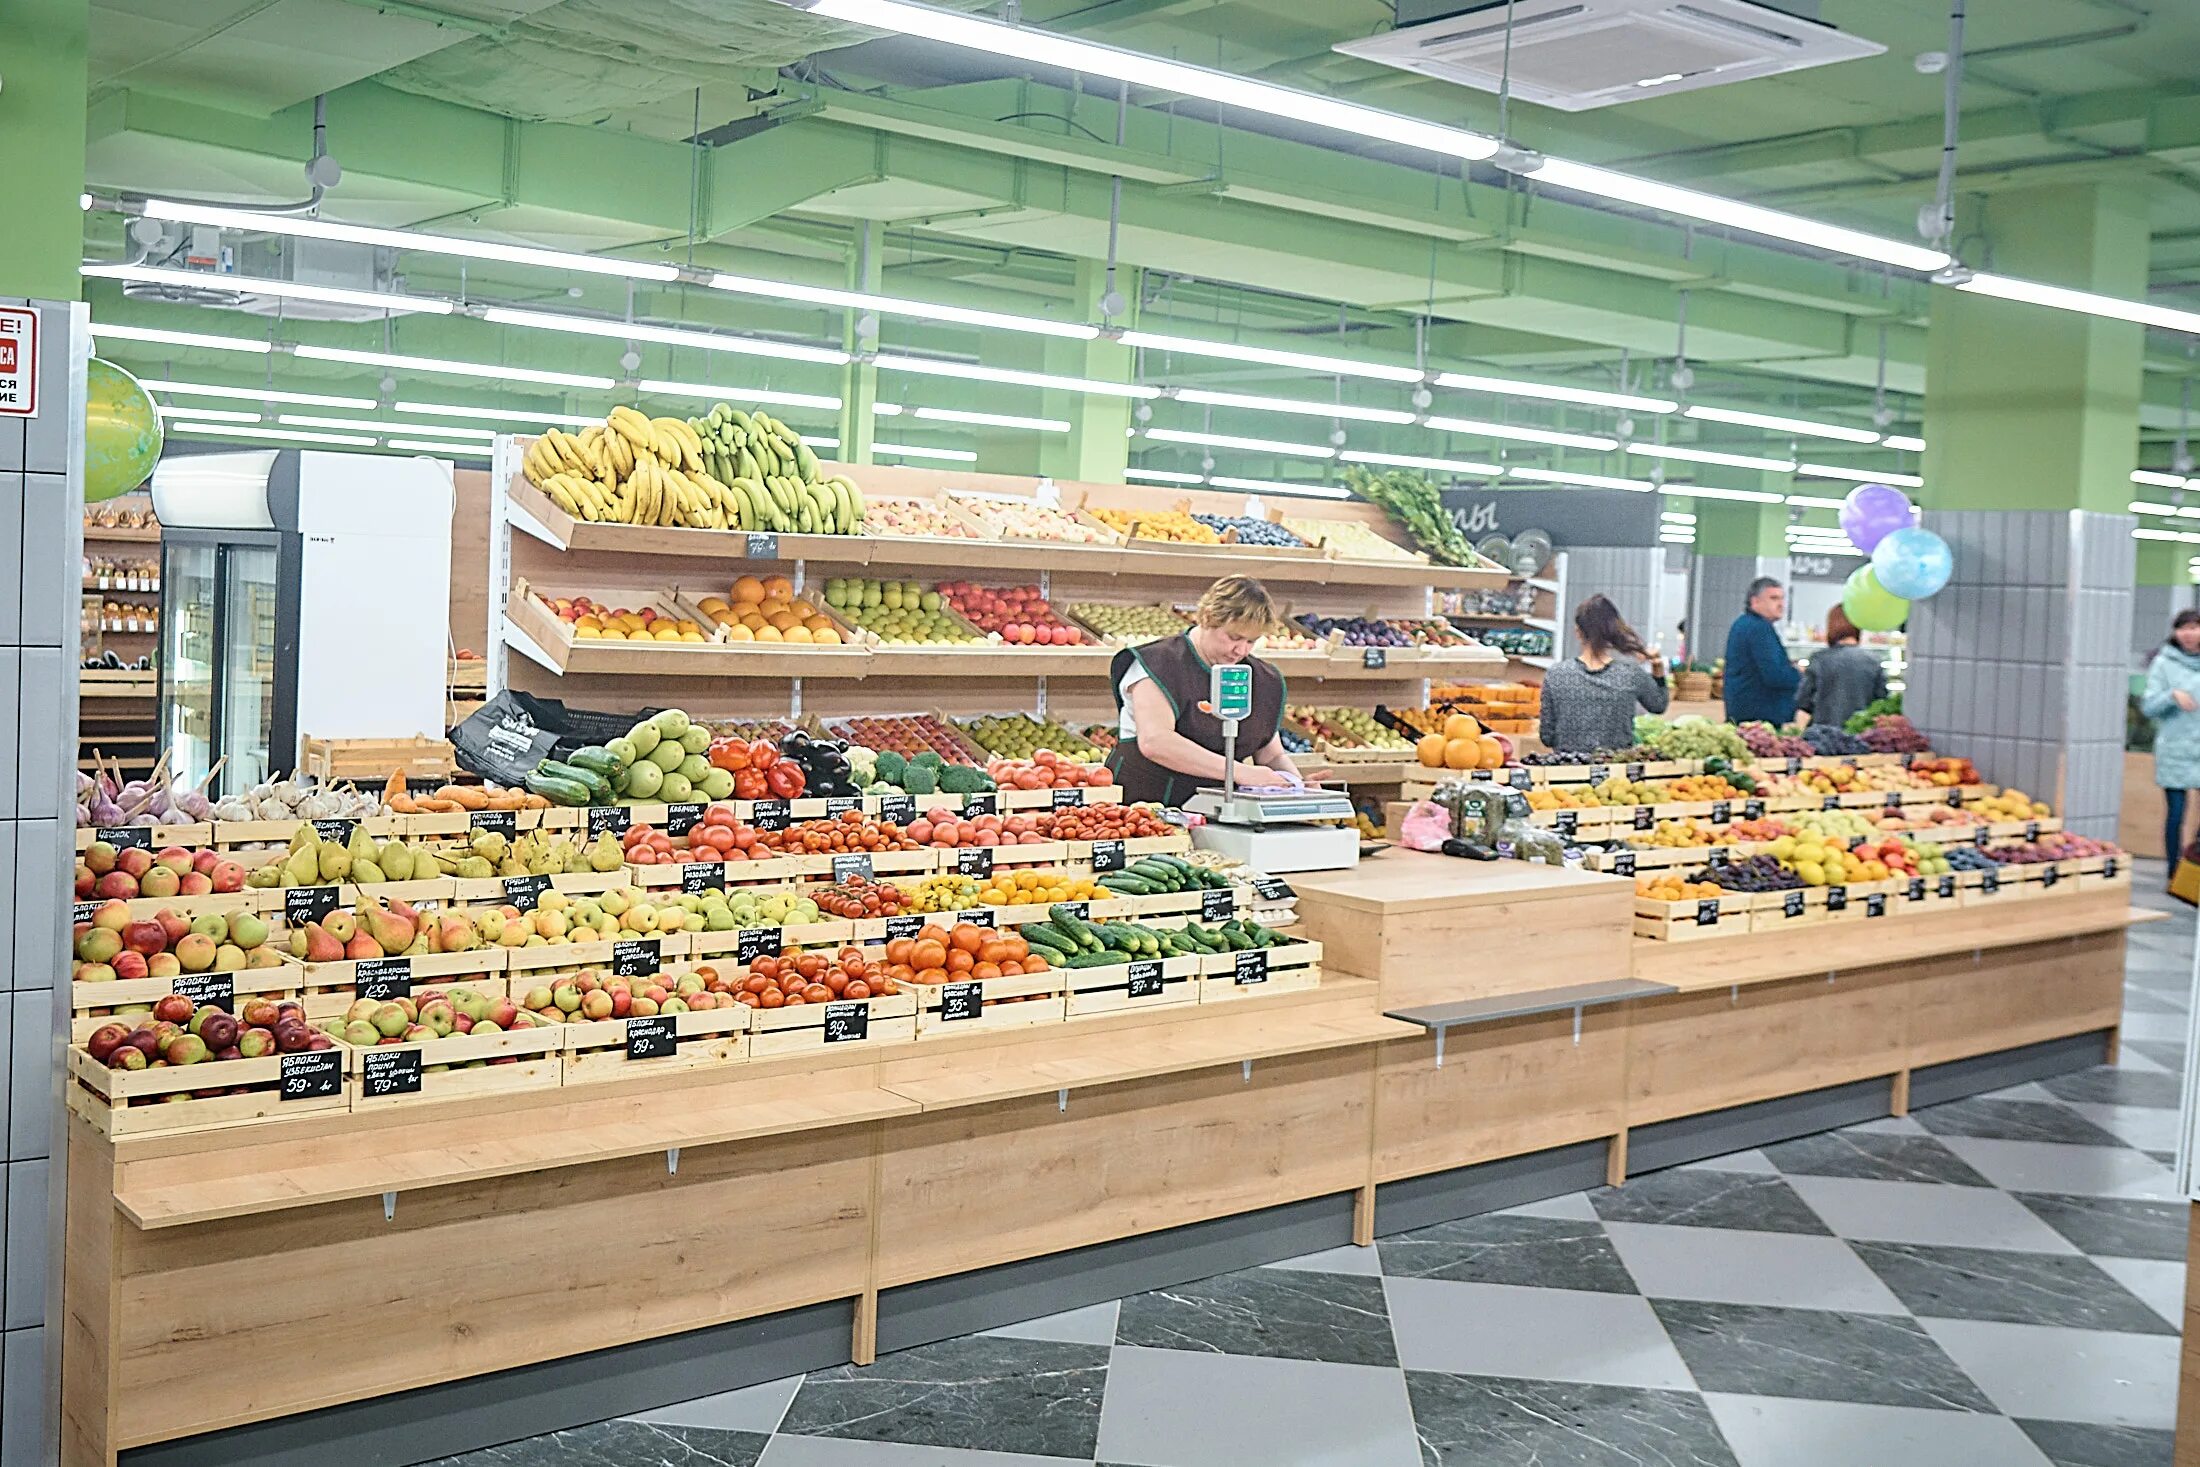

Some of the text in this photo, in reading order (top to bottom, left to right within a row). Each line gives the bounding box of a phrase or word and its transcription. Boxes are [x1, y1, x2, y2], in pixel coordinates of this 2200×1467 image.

[98, 830, 131, 839] ЧЕСНОК
[287, 890, 315, 899] ГРУША
[357, 960, 384, 970] ГРУША
[173, 976, 212, 989] ЯБЛОКИ
[282, 1054, 321, 1069] ЯБЛОКИ
[365, 1052, 401, 1064] ЯБЛОКИ
[284, 1062, 334, 1078] УЗБЕКИСТАН
[367, 1061, 396, 1073] ПРИМА
